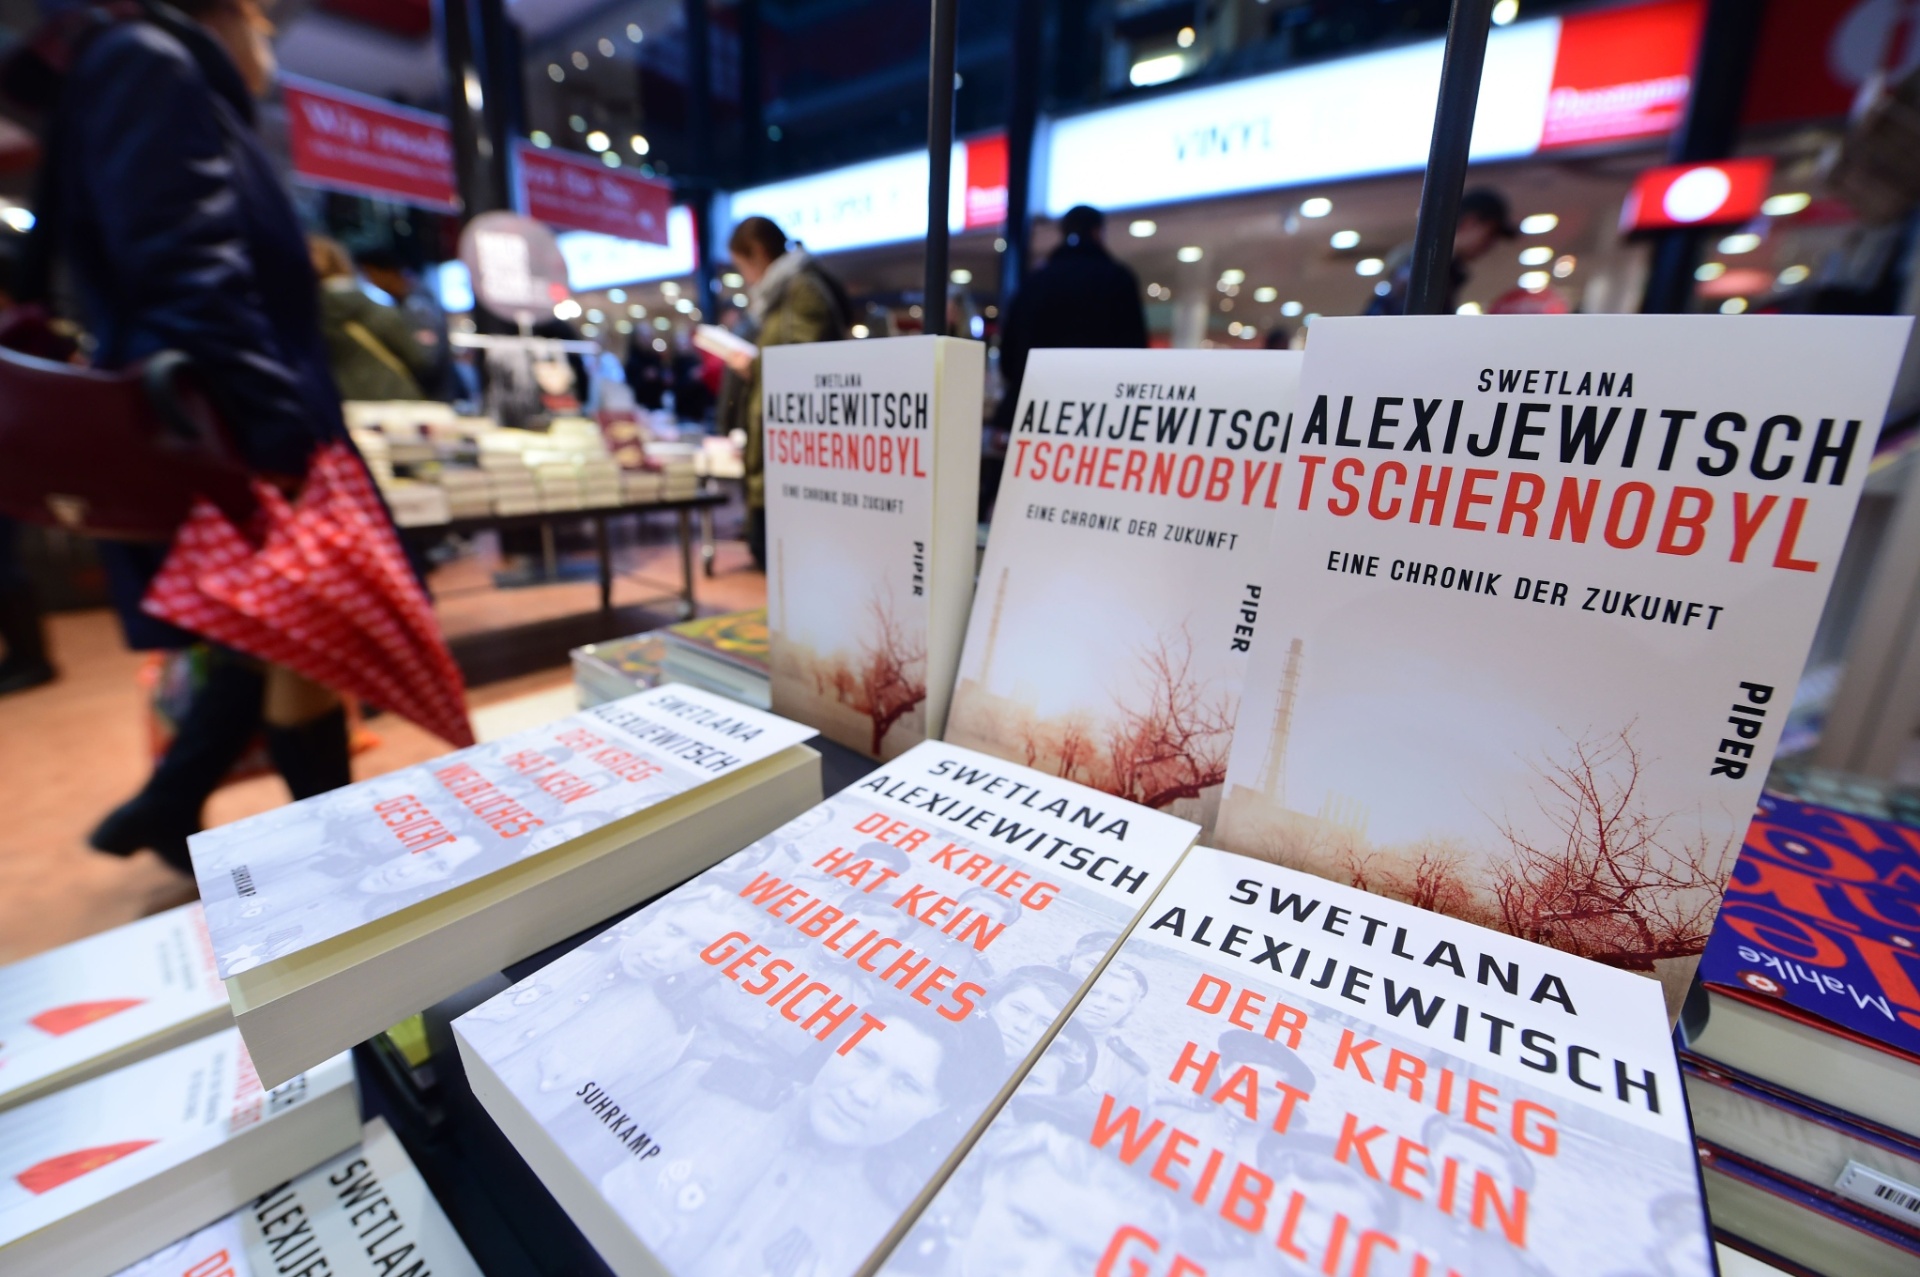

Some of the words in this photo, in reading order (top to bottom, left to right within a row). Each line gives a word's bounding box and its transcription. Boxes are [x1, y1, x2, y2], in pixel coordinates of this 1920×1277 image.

[767, 392, 928, 430] ALEXIJEWITSCH
[814, 373, 862, 388] SWETLANA
[1115, 383, 1196, 401] SWETLANA
[1478, 368, 1634, 398] SWETLANA
[767, 428, 927, 478] TSCHERNOBYL
[1012, 439, 1284, 510] TSCHERNOBYL
[1301, 394, 1861, 486] ALEXIJEWITSCH
[782, 483, 799, 499] EINE
[803, 486, 838, 504] CHRONIK
[841, 491, 858, 507] DER
[862, 494, 903, 514] ZUKUNFT
[1026, 503, 1057, 523] EINE
[1061, 509, 1121, 533] CHRONIK
[1128, 518, 1157, 538] DER
[1163, 524, 1239, 551] ZUKUNFT
[1298, 455, 1820, 573] TSCHERNOBYL
[912, 540, 925, 597] PIPER
[1326, 550, 1381, 578] EINE
[1390, 558, 1502, 598] CHRONIK
[1514, 576, 1568, 607] DER
[1581, 587, 1724, 632] ZUKUNFT
[1230, 584, 1262, 654] PIPER
[554, 727, 605, 752] DER
[587, 745, 664, 783] KRIEG
[648, 694, 765, 743] SWETLANA
[1709, 681, 1775, 781] PIPER
[432, 761, 545, 840] WEIBLICHES
[501, 747, 557, 777] HAT
[531, 768, 600, 805] KEIN
[926, 759, 1132, 843] SWETLANA
[372, 793, 458, 856] GESICHT
[852, 812, 931, 854] DER
[926, 841, 1062, 912] KRIEG
[858, 773, 1150, 895] ALEXIJEWITSCH
[811, 846, 900, 897] HAT
[905, 884, 1007, 953] KEIN
[736, 871, 988, 1025] WEIBLICHES
[1228, 878, 1579, 1017] SWETLANA
[1736, 944, 1896, 1022] Mahlke
[697, 930, 888, 1059] GESICHT
[1149, 906, 1664, 1115] ALEXIJEWITSCH
[1184, 972, 1310, 1052] DER
[1331, 1028, 1561, 1158] KRIEG
[575, 1082, 662, 1164] SUHRKAMP
[1166, 1040, 1312, 1139] HAT
[1332, 1113, 1531, 1250] KEIN
[253, 1180, 333, 1277] LEXIJE
